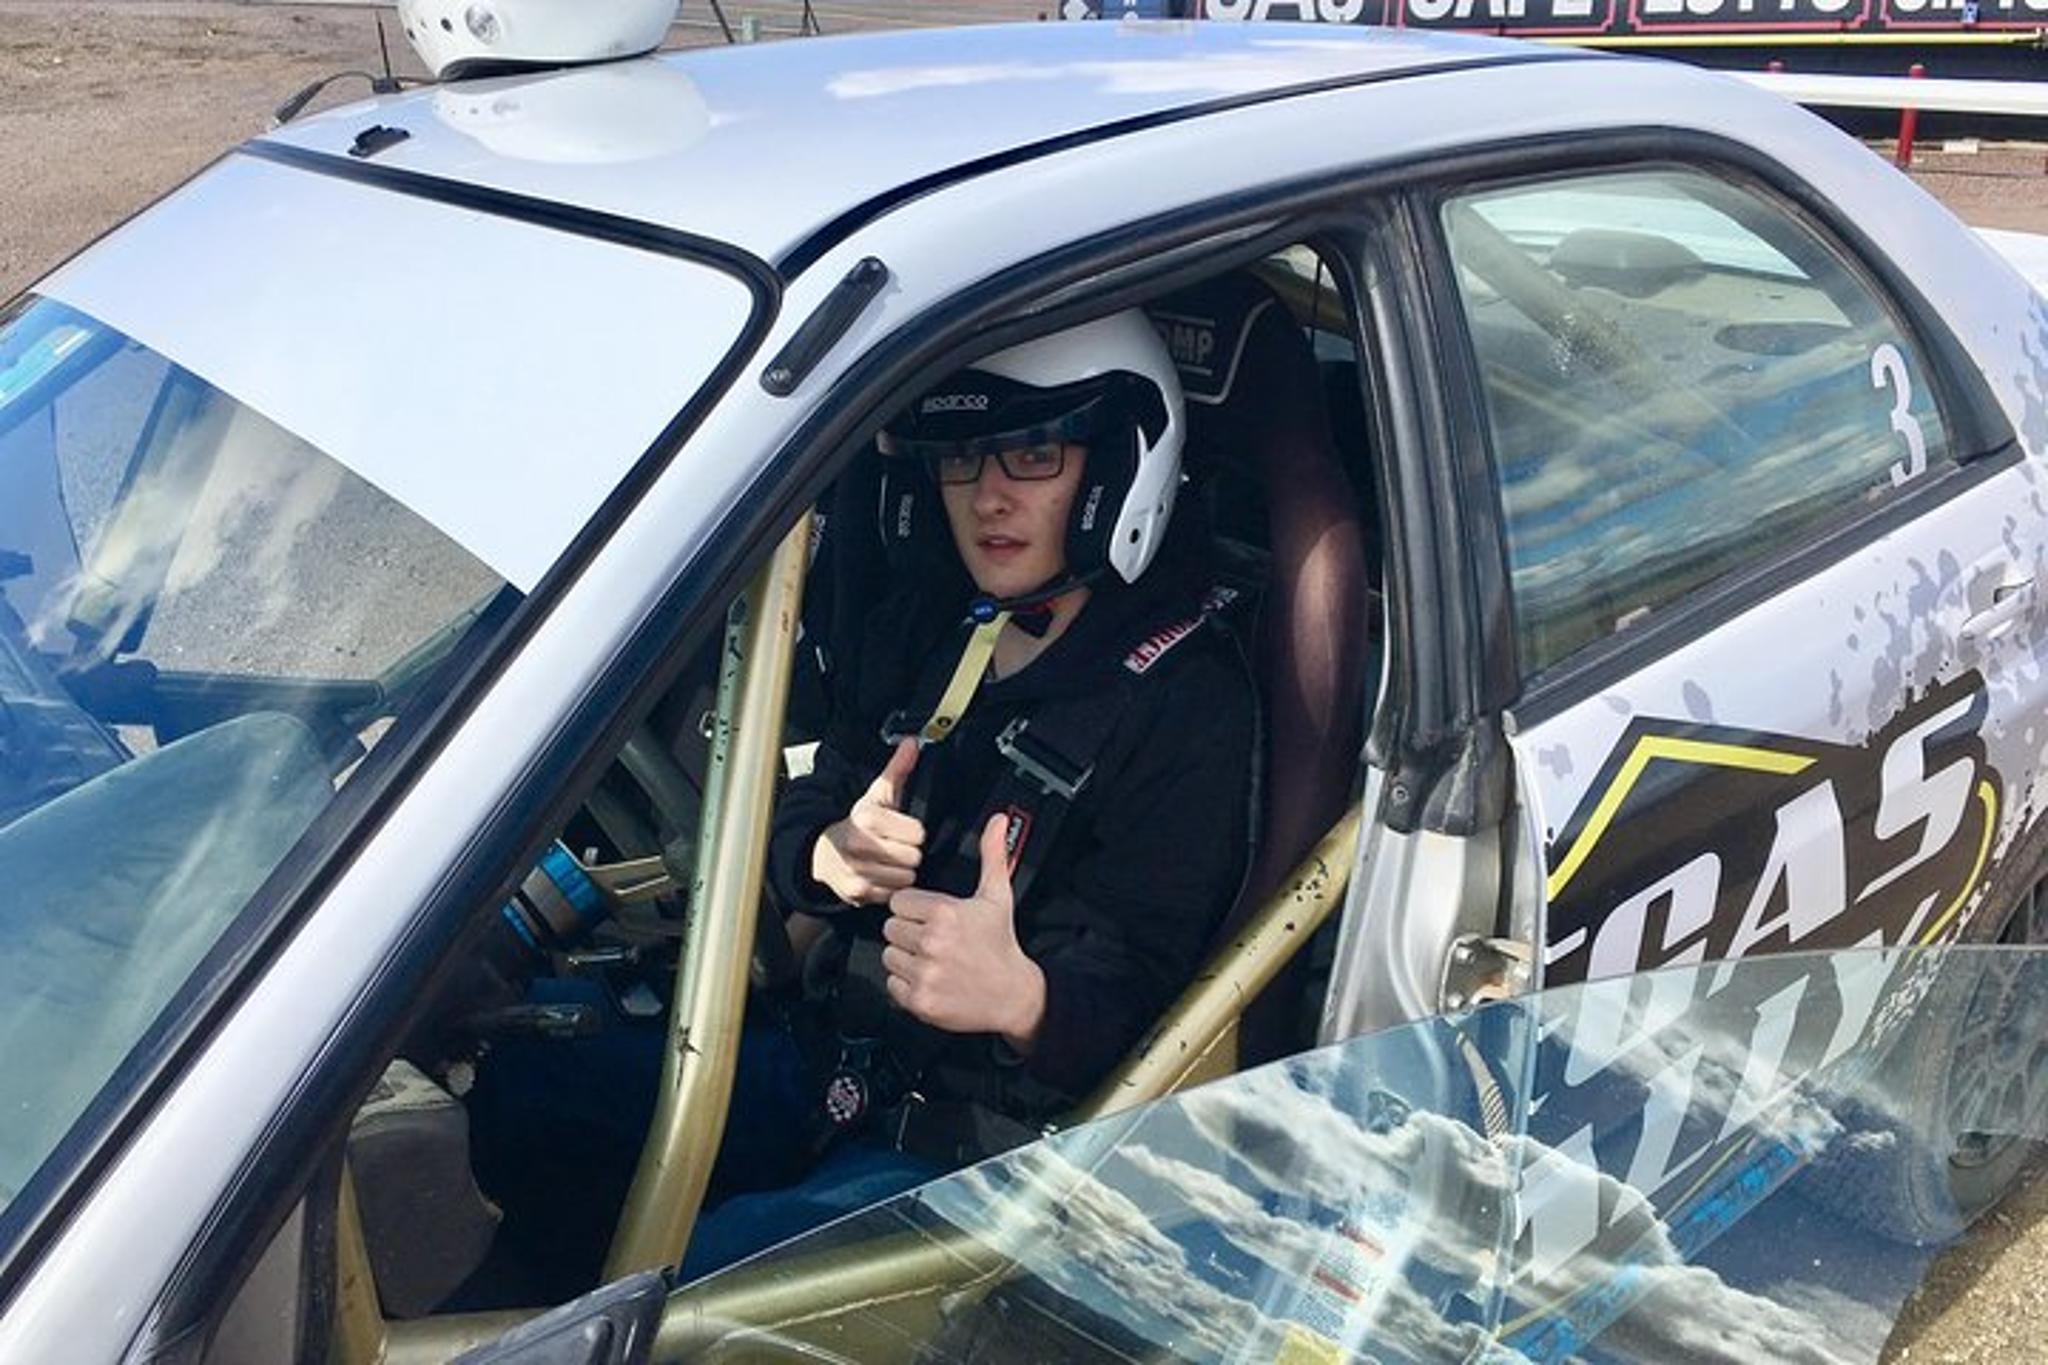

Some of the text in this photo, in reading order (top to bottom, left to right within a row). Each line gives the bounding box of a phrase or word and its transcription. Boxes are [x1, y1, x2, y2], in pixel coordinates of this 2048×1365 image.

[1161, 322, 1215, 364] MP
[1871, 343, 1928, 488] 3
[1540, 693, 1976, 1112] GAS
